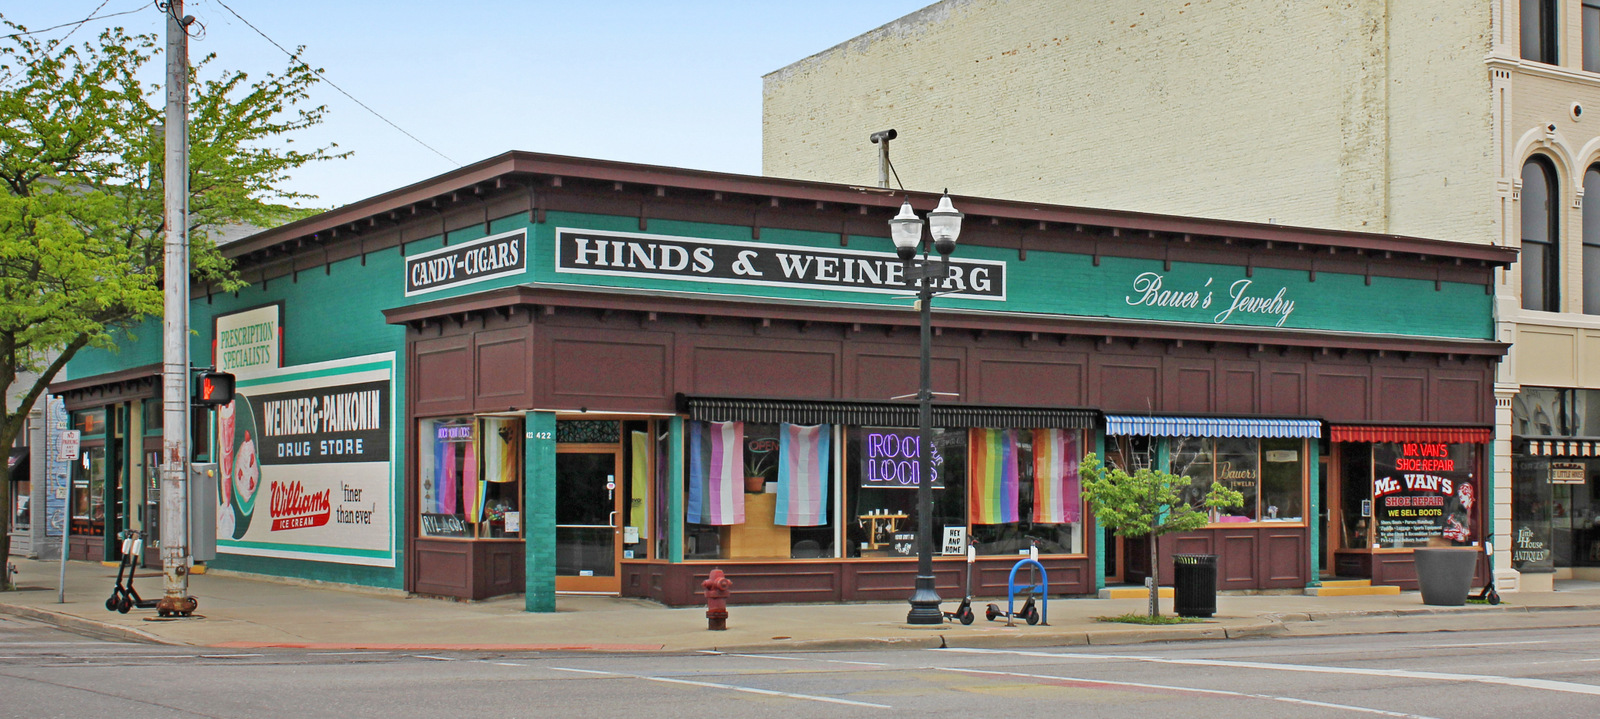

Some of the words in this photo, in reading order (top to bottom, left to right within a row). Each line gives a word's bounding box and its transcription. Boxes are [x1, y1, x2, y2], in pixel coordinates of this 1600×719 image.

[411, 239, 519, 287] CANDY-CIGARS
[574, 238, 714, 274] HINDS
[731, 250, 763, 276] &
[1125, 271, 1213, 309] Bauer's
[1213, 279, 1295, 327] Jewelry
[220, 320, 274, 350] PRESCRIPTION
[223, 344, 271, 370] SPECIALISTS
[263, 389, 380, 437] WEINBERG-PANKONIN
[277, 441, 312, 458] DRUG
[320, 438, 364, 456] STORE
[750, 441, 779, 451] OPEN
[868, 433, 920, 457] ROC
[1403, 443, 1419, 457] MR
[1419, 443, 1448, 458] VAN'S
[1217, 461, 1256, 480] Bauer's
[1395, 458, 1421, 471] SHOE
[1421, 459, 1455, 472] REPAIR
[1556, 470, 1571, 479] LITTLE
[1374, 476, 1402, 497] Mr.
[1403, 473, 1454, 497] VAN'S
[270, 480, 330, 519] Williams
[1384, 496, 1411, 507] SHOE
[1411, 495, 1444, 507] REPAIR
[336, 504, 355, 524] than
[1387, 509, 1400, 517] WE
[1400, 509, 1418, 517] SELL
[1418, 508, 1443, 517] BOOTS
[279, 518, 290, 529] ICE
[291, 516, 314, 528] CREAM
[949, 529, 961, 537] HEX
[1517, 529, 1534, 542] Little
[945, 545, 961, 554] HOME
[1519, 536, 1543, 549] House
[1513, 550, 1544, 562] ANTIQUES
